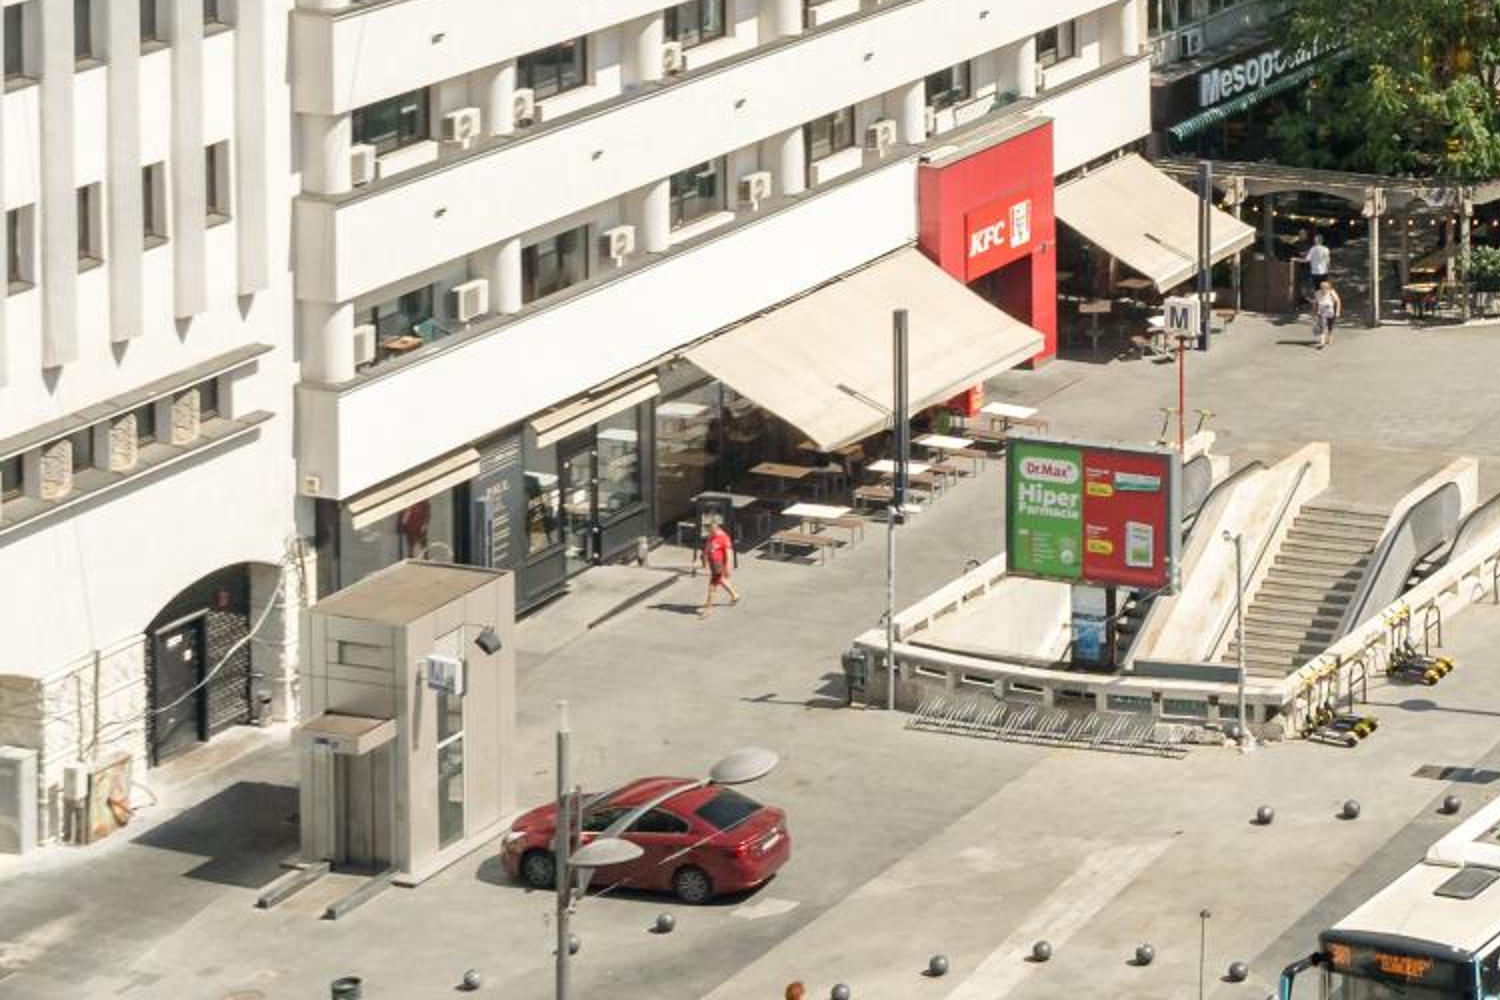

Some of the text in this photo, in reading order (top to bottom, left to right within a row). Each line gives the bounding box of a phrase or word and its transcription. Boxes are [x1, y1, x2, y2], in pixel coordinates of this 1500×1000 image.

[969, 220, 1005, 257] KFC
[1169, 306, 1189, 330] M
[1019, 482, 1080, 508] Hiper
[1018, 502, 1079, 520] Farmacia
